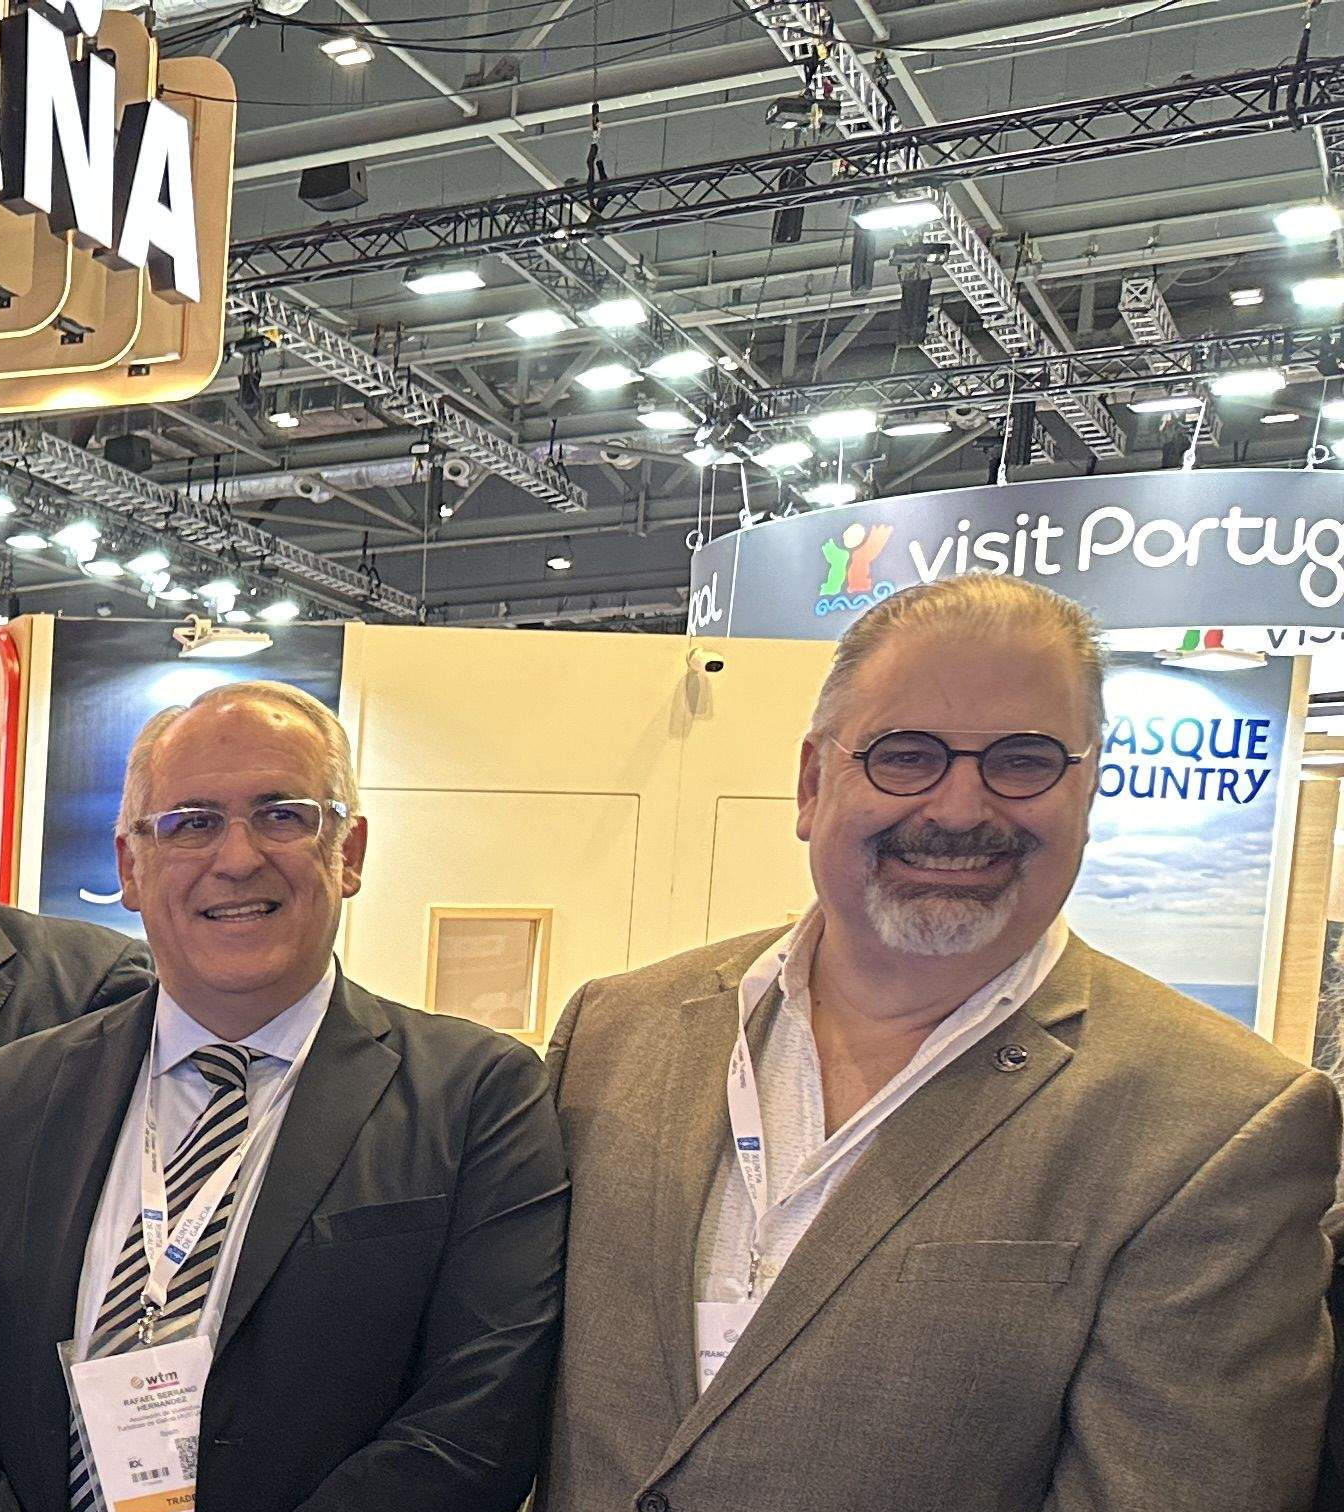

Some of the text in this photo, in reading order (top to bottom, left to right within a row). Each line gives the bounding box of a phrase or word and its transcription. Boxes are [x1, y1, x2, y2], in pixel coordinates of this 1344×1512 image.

[909, 506, 1344, 608] visit Portug
[1101, 715, 1271, 762] ASQUE
[1098, 763, 1272, 805] OUNTRY
[146, 1371, 179, 1386] wtm
